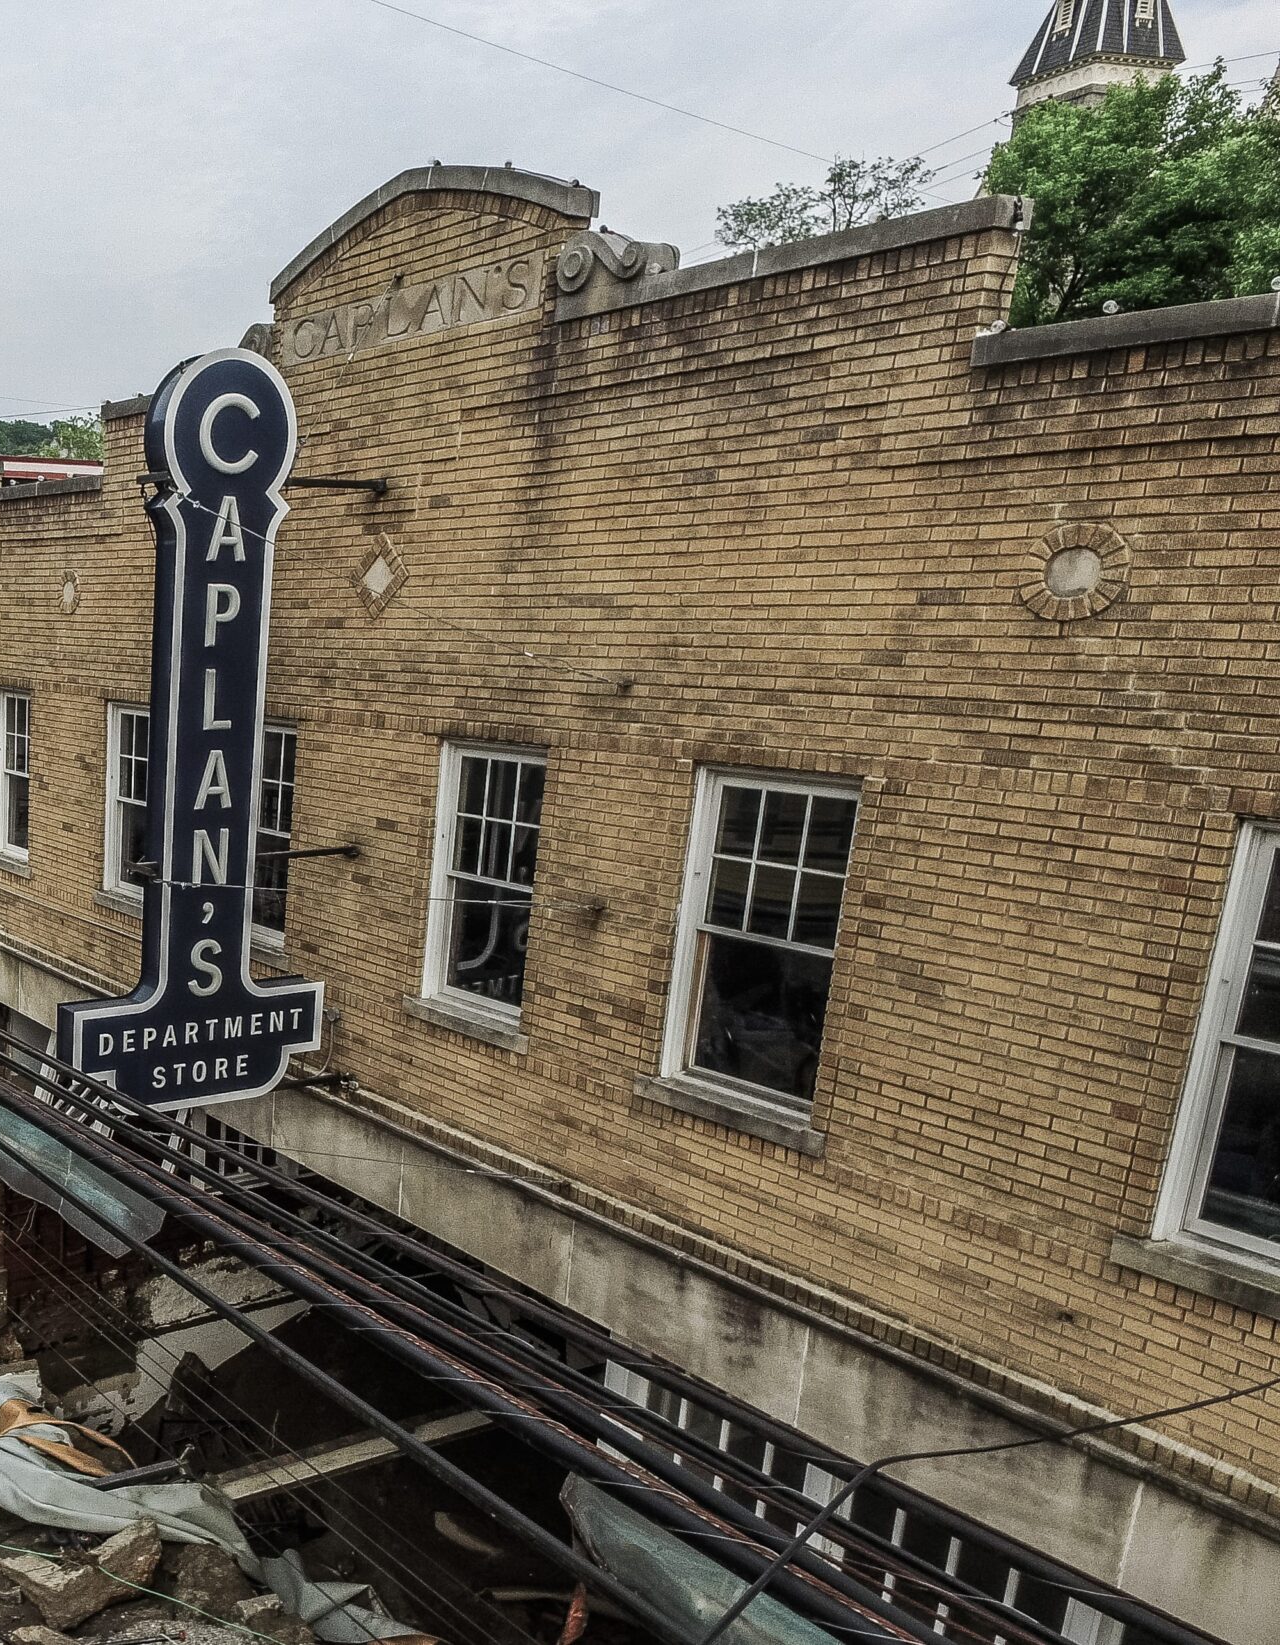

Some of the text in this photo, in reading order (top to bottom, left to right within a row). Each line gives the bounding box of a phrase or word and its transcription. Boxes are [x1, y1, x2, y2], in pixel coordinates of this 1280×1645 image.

[292, 258, 531, 359] CAPLAN'S
[187, 392, 261, 997] CAPLAN'S
[98, 1007, 304, 1057] DEPARTMENT
[151, 1054, 249, 1090] STORE
